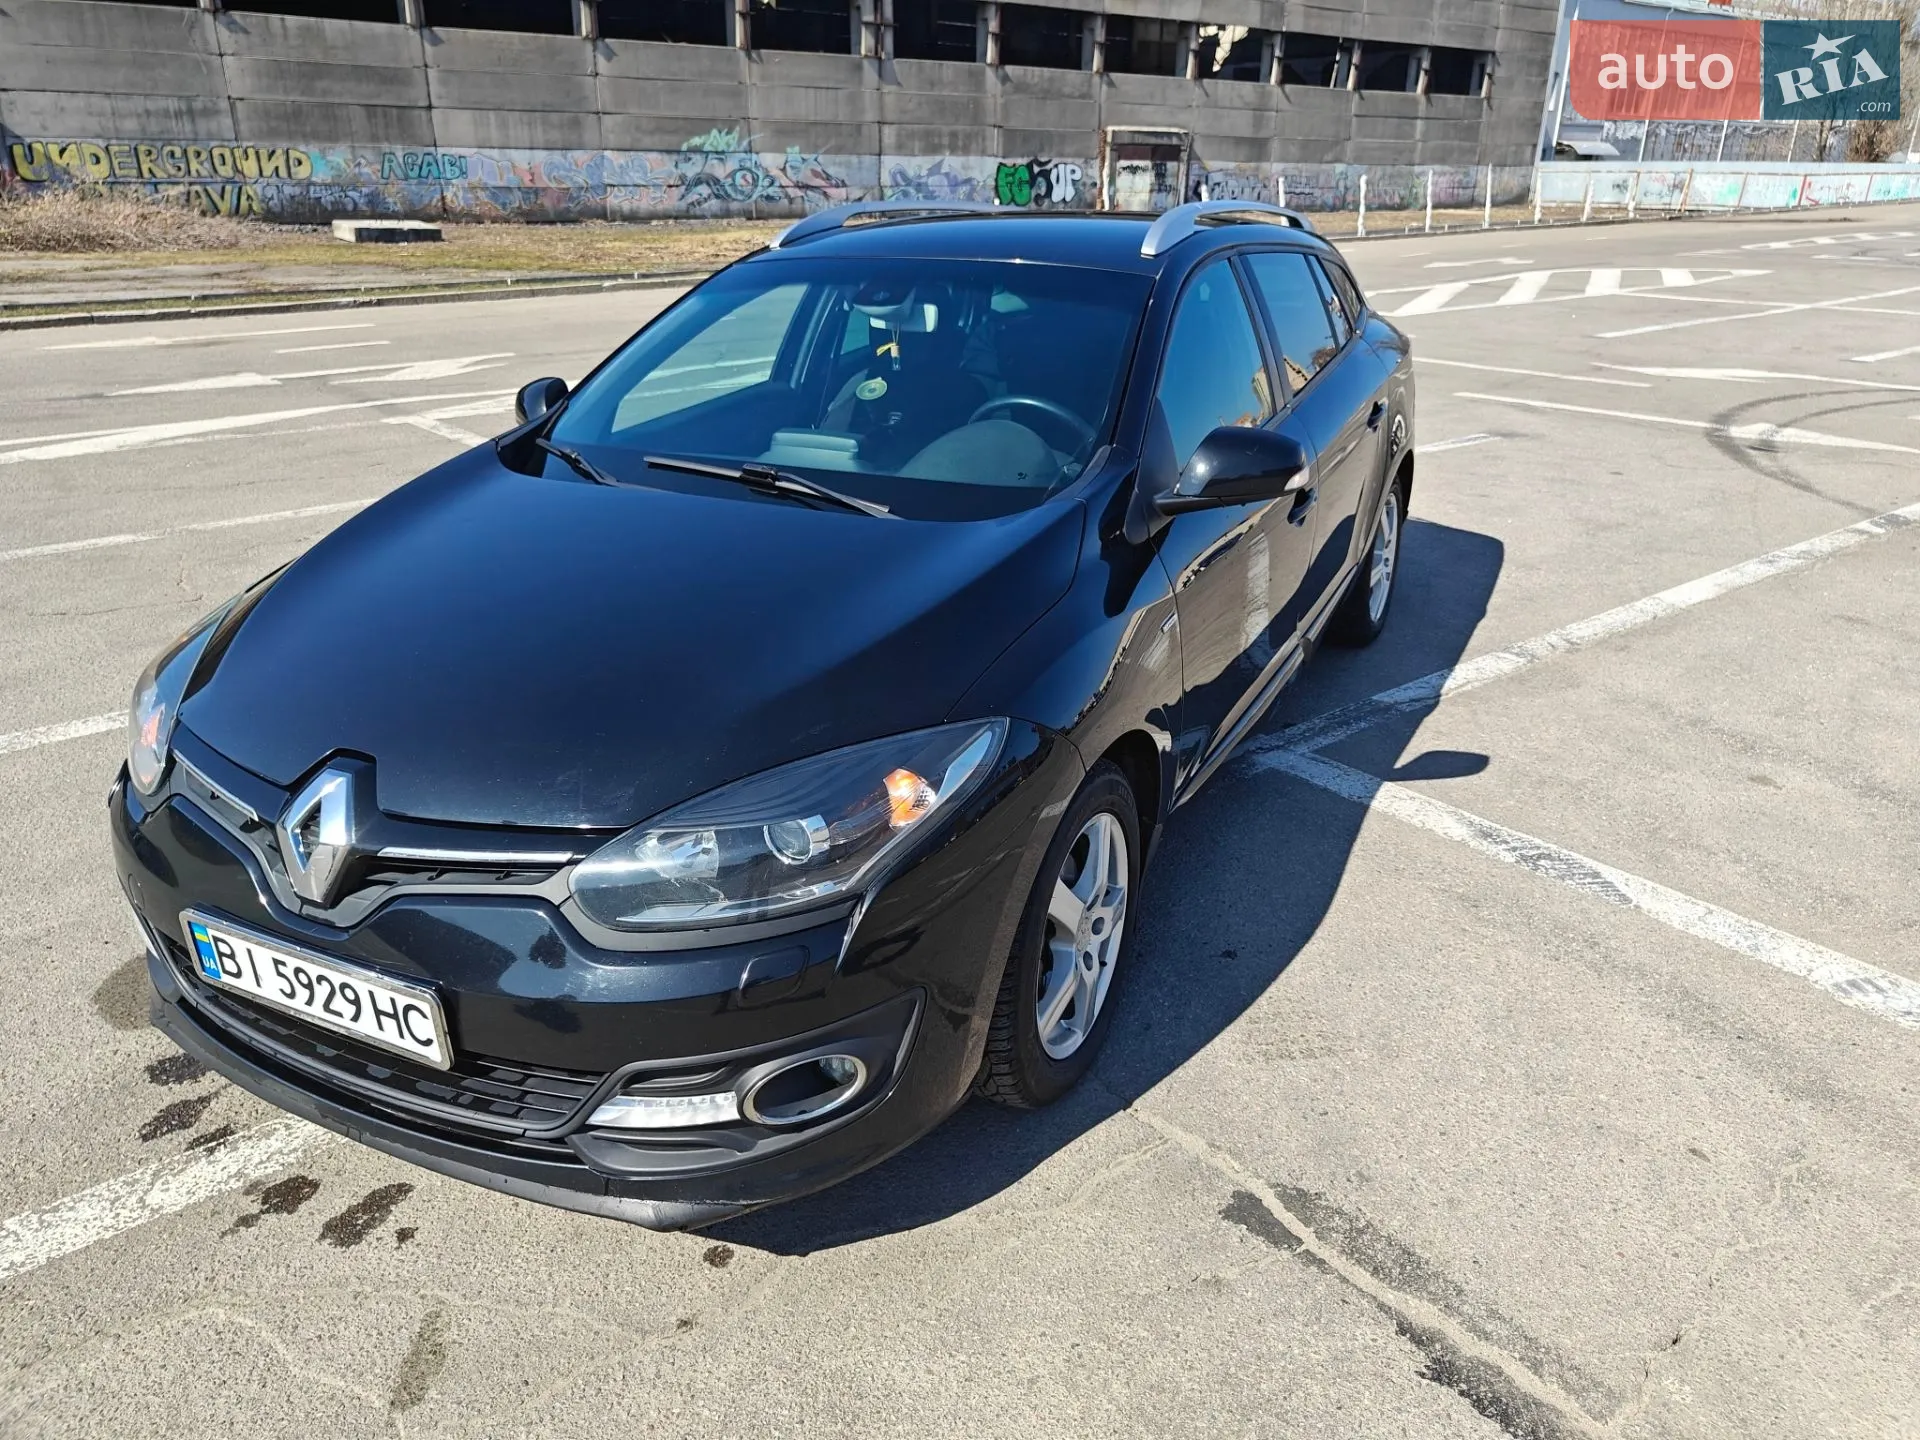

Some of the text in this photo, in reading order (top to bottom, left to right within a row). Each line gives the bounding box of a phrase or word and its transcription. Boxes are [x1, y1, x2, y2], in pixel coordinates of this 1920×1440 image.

[10, 141, 313, 182] UNDERGROUND
[201, 957, 218, 972] UA
[211, 934, 434, 1047] BI 5929 HC
